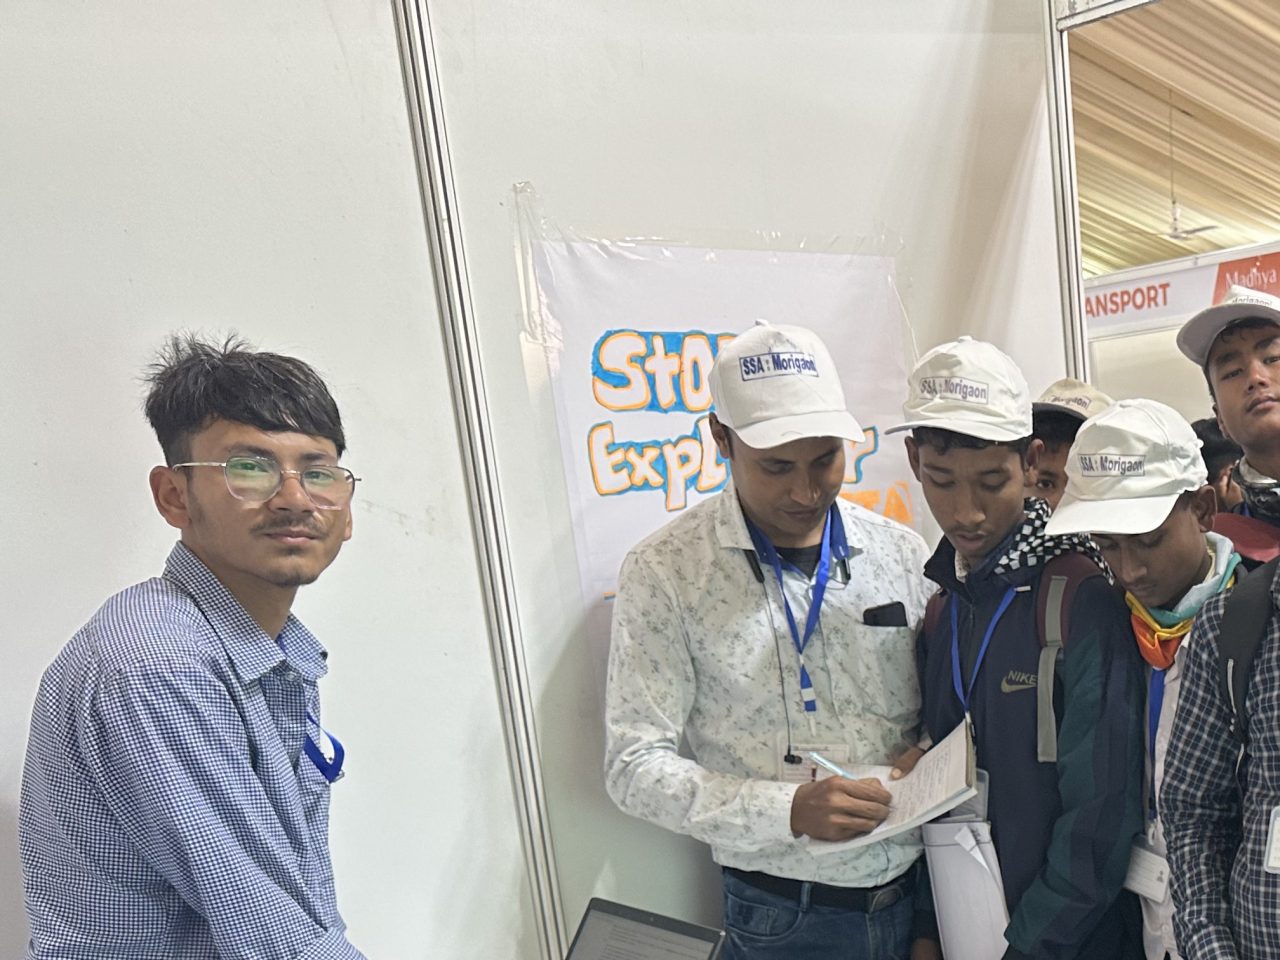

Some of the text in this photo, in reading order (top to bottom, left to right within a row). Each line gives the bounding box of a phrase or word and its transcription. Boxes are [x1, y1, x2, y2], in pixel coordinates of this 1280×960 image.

[1225, 262, 1277, 290] Madhya
[1085, 282, 1171, 318] ANSPORT
[743, 356, 765, 375] SSA
[920, 379, 938, 395] SSA
[943, 378, 987, 400] Morigaon
[1080, 456, 1095, 472] SSA
[1100, 456, 1143, 475] Morigaon
[1007, 670, 1038, 686] NIKE
